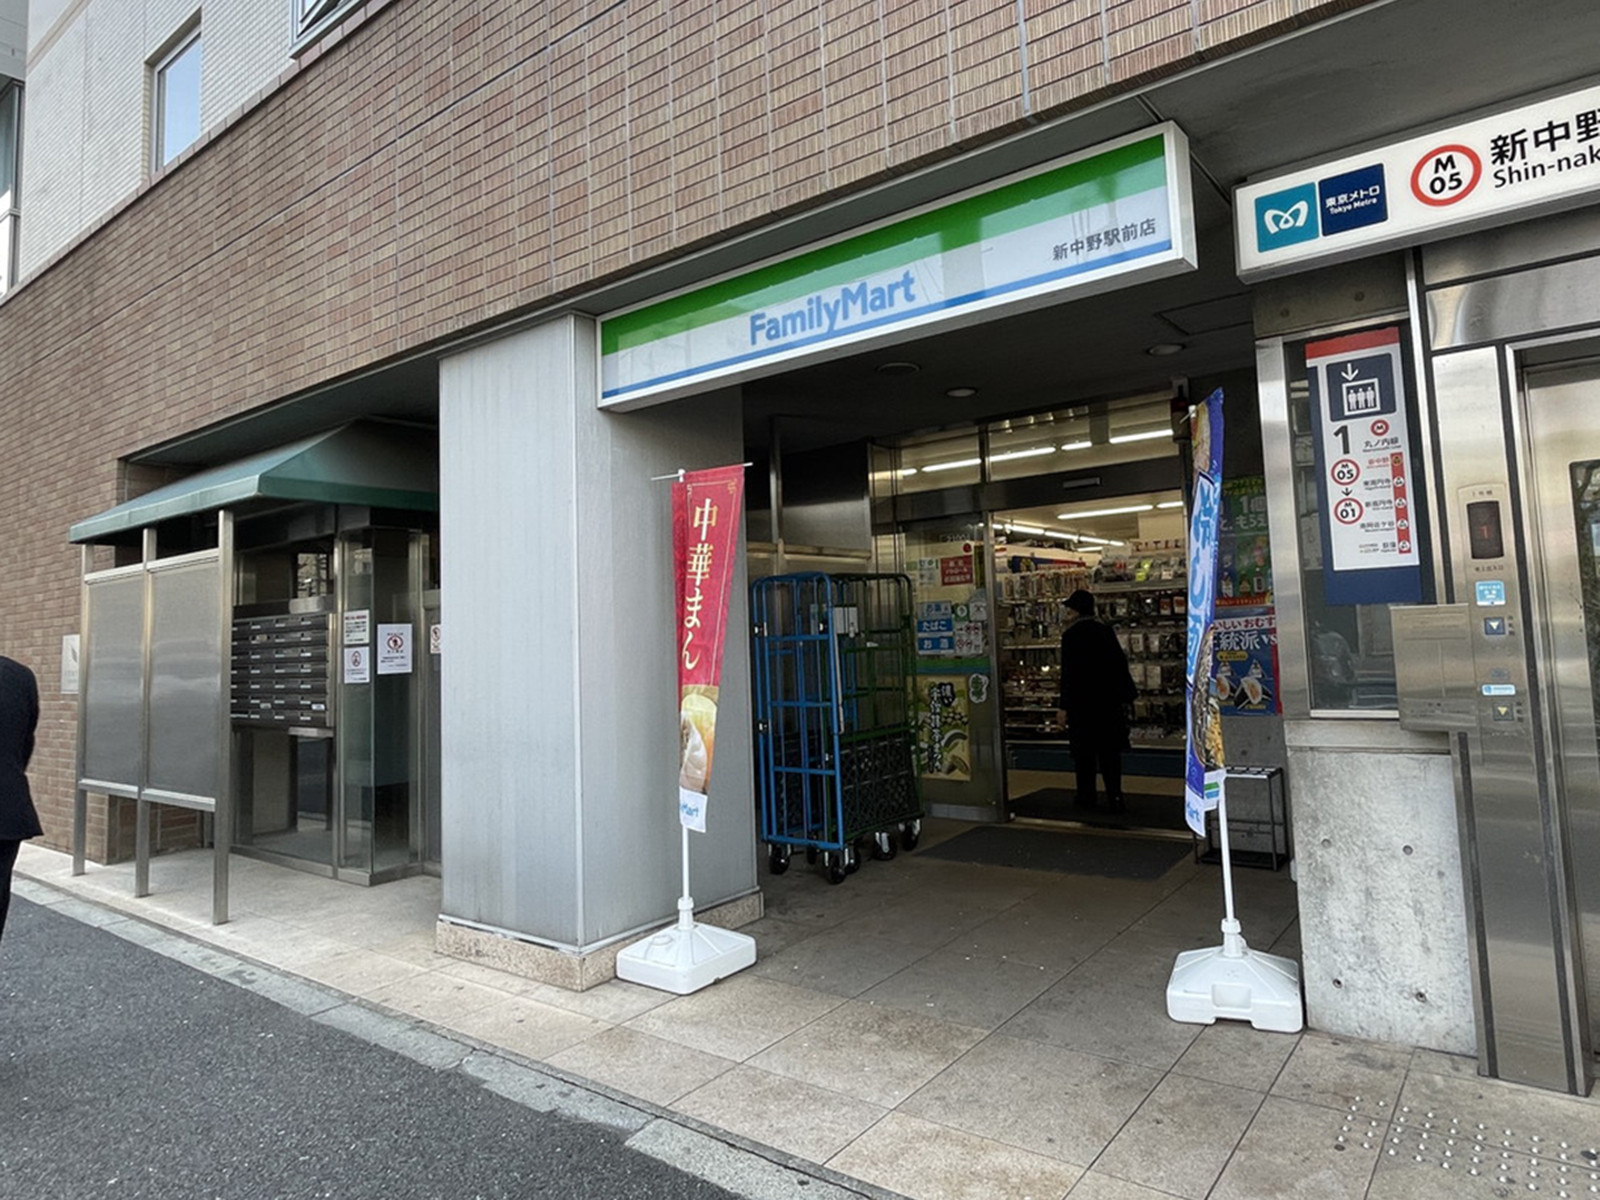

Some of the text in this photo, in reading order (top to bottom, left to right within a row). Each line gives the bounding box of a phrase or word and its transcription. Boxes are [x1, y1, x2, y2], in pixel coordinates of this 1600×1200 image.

[1434, 154, 1456, 174] M
[1493, 144, 1600, 188] Shin-nak
[1429, 171, 1463, 194] 05
[1325, 185, 1380, 208] 東京メトロ
[1329, 197, 1377, 214] Tokyo Metro
[1052, 217, 1157, 261] 新中野駅前店
[750, 269, 916, 346] FamilyMart
[1333, 425, 1350, 455] 1
[1336, 469, 1354, 480] 05
[1340, 508, 1356, 519] 01
[682, 498, 719, 670] 中華まん
[922, 620, 948, 632] たばこ
